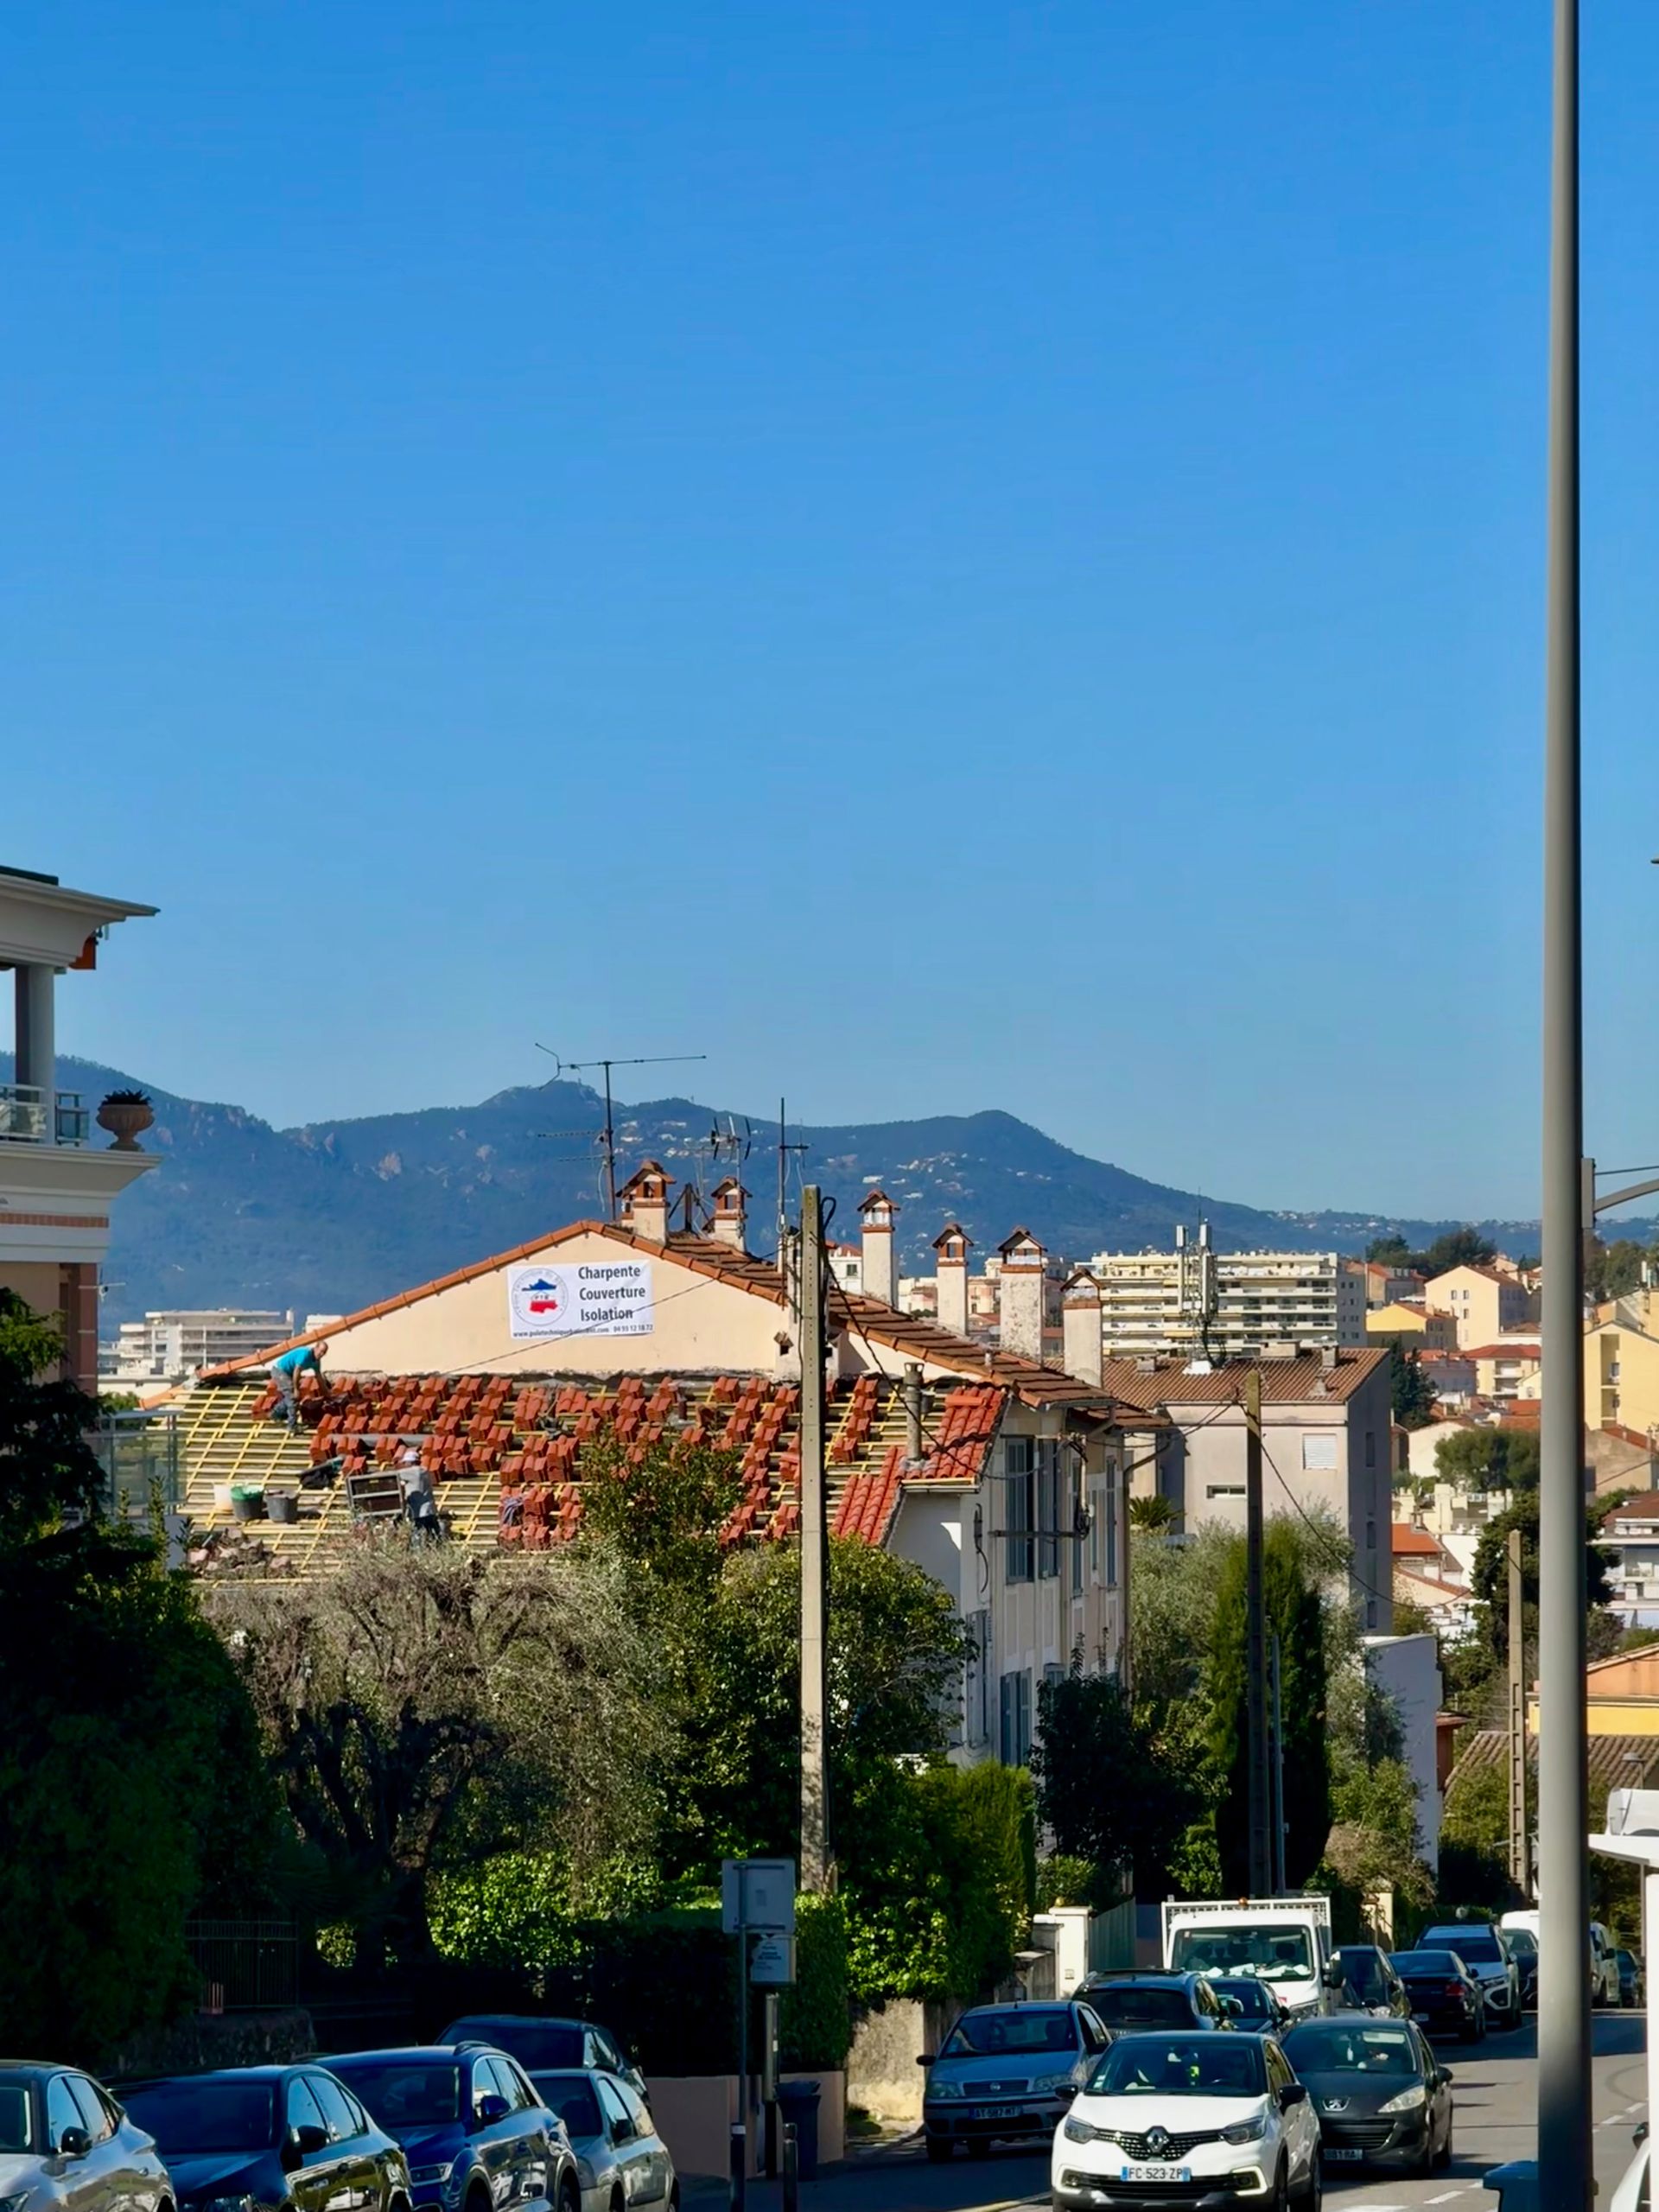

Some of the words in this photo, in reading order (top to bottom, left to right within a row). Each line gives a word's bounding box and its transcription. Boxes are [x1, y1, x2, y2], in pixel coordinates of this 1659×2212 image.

[578, 1265, 641, 1281] Charpente
[579, 1286, 645, 1300] Couverture
[580, 1306, 633, 1321] Isolation
